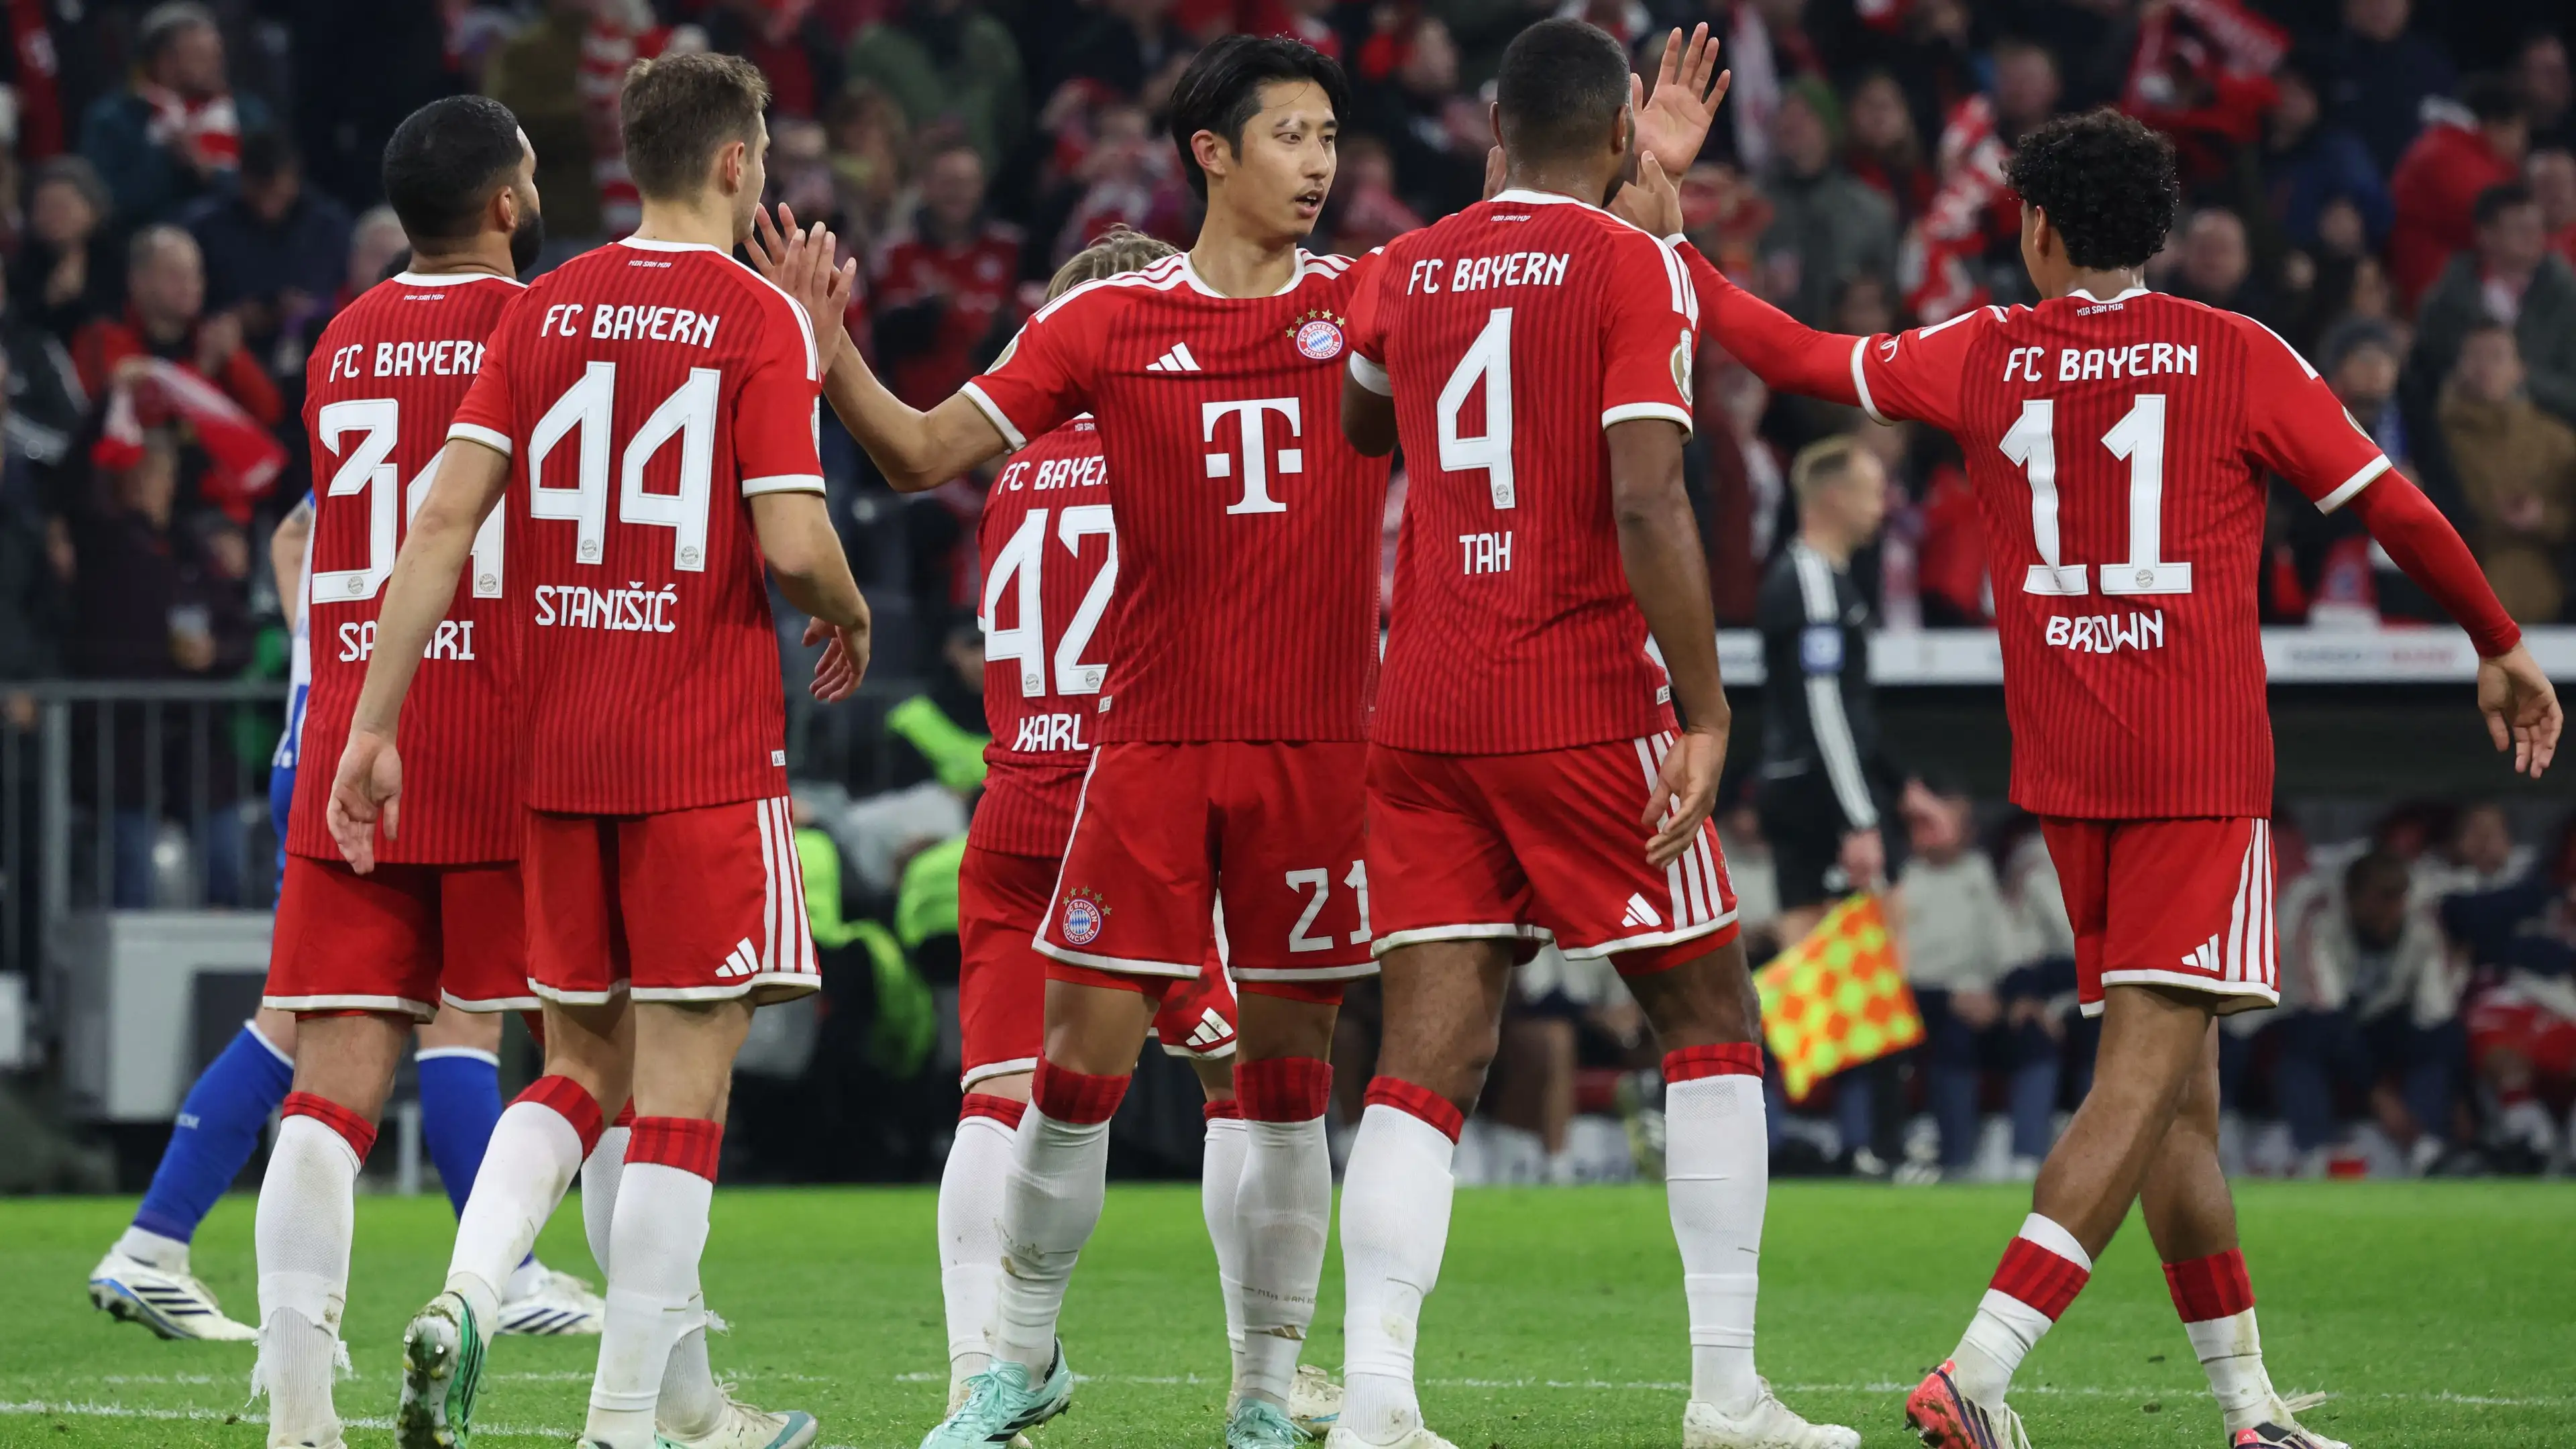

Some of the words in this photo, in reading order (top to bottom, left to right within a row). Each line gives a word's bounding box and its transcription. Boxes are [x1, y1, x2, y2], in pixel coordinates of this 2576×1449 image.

[1407, 259, 1443, 296] FC
[1452, 252, 1570, 292] BAYERN
[541, 305, 584, 337] FC
[590, 304, 720, 349] BAYERN
[1306, 324, 1338, 336] BAYERN
[2076, 307, 2091, 317] MIA
[2091, 305, 2107, 315] SAN
[2108, 303, 2124, 311] MIA
[329, 343, 363, 383] FC
[2003, 346, 2045, 382] FC
[2059, 343, 2198, 382] BAYERN
[1436, 307, 1515, 510] 4
[528, 360, 721, 572] 44
[998, 462, 1031, 495] FC
[1998, 394, 2192, 596] 11
[1459, 531, 1512, 575] TAH
[535, 581, 678, 633] STANIŠIĆ
[985, 504, 1119, 698] 42
[339, 620, 475, 662] SARI
[2045, 609, 2163, 654] BROWN
[1012, 713, 1089, 752] KARL
[1074, 902, 1097, 922] BAYERN
[1285, 859, 1373, 953] 21
